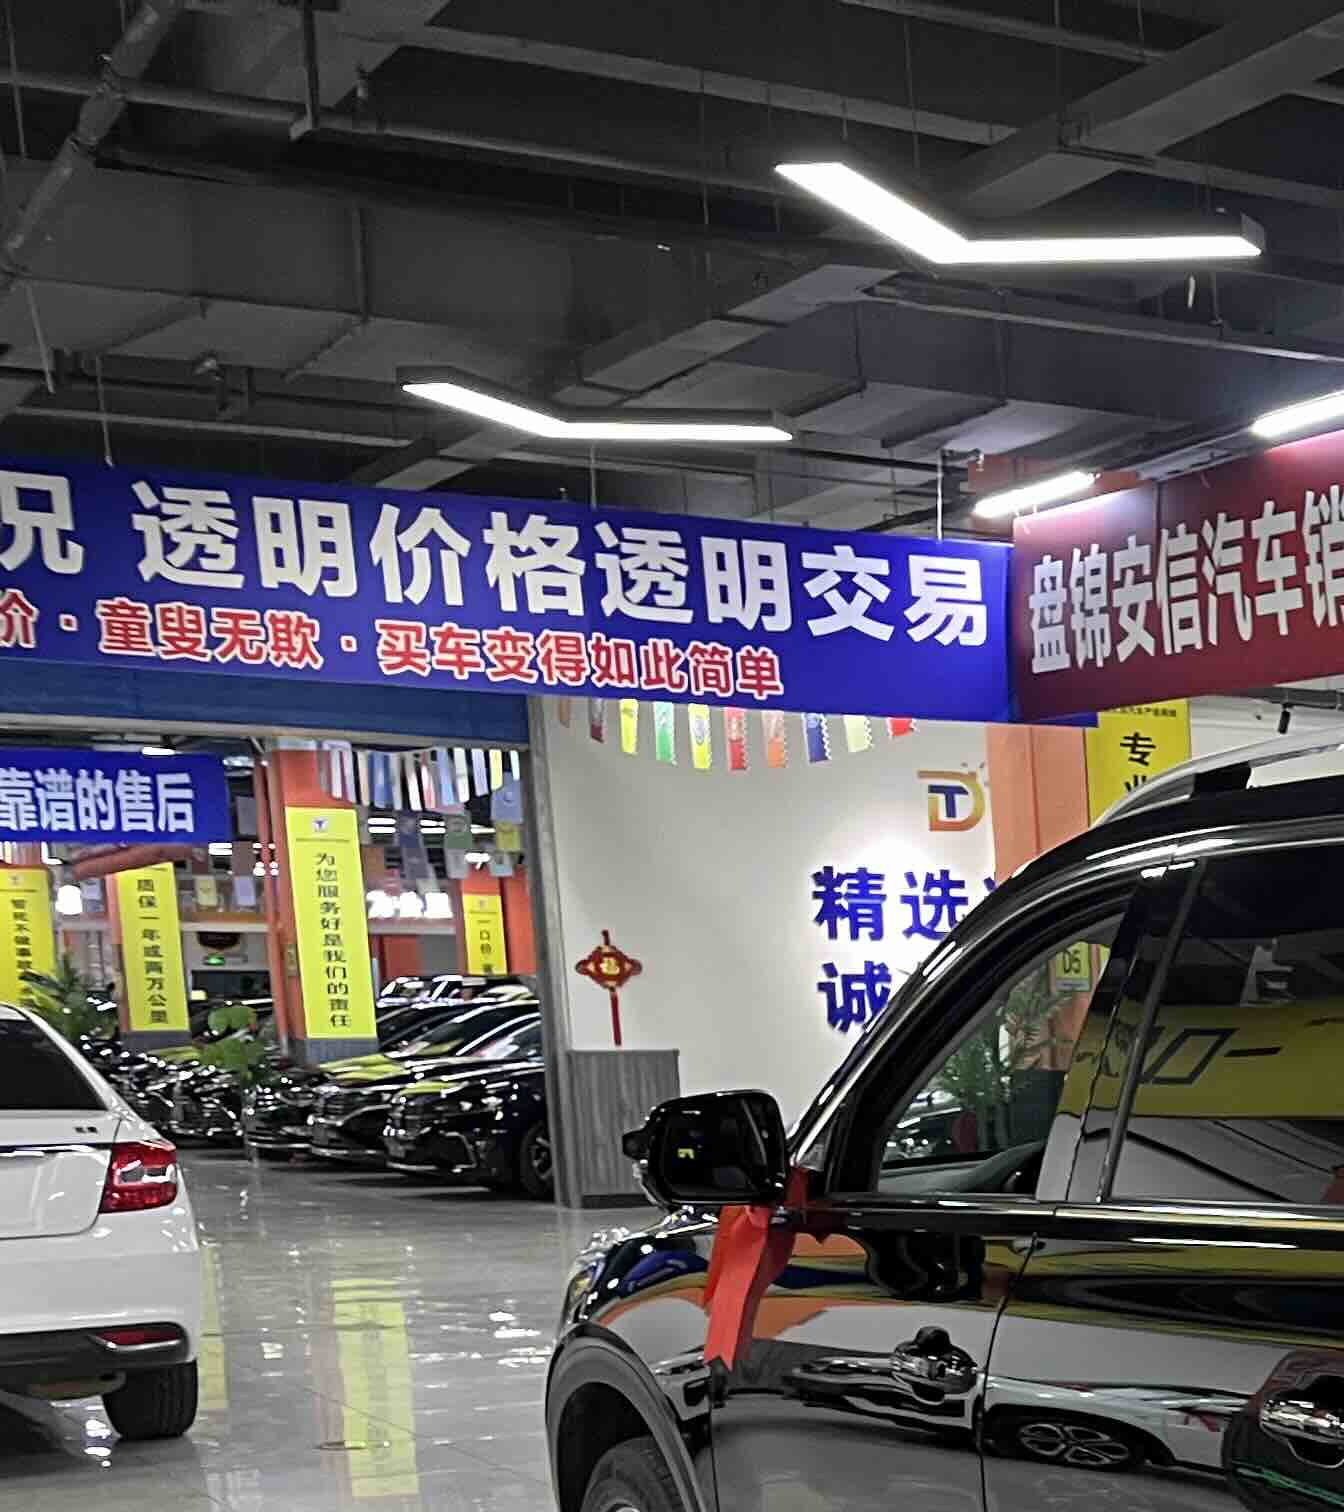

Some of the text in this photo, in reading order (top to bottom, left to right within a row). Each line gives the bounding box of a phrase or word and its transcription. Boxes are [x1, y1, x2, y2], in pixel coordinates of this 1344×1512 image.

[131, 481, 988, 646] 透明价格透明交易
[316, 852, 351, 1028] 为您服务好是我们的责任
[811, 866, 1001, 941] 精选
